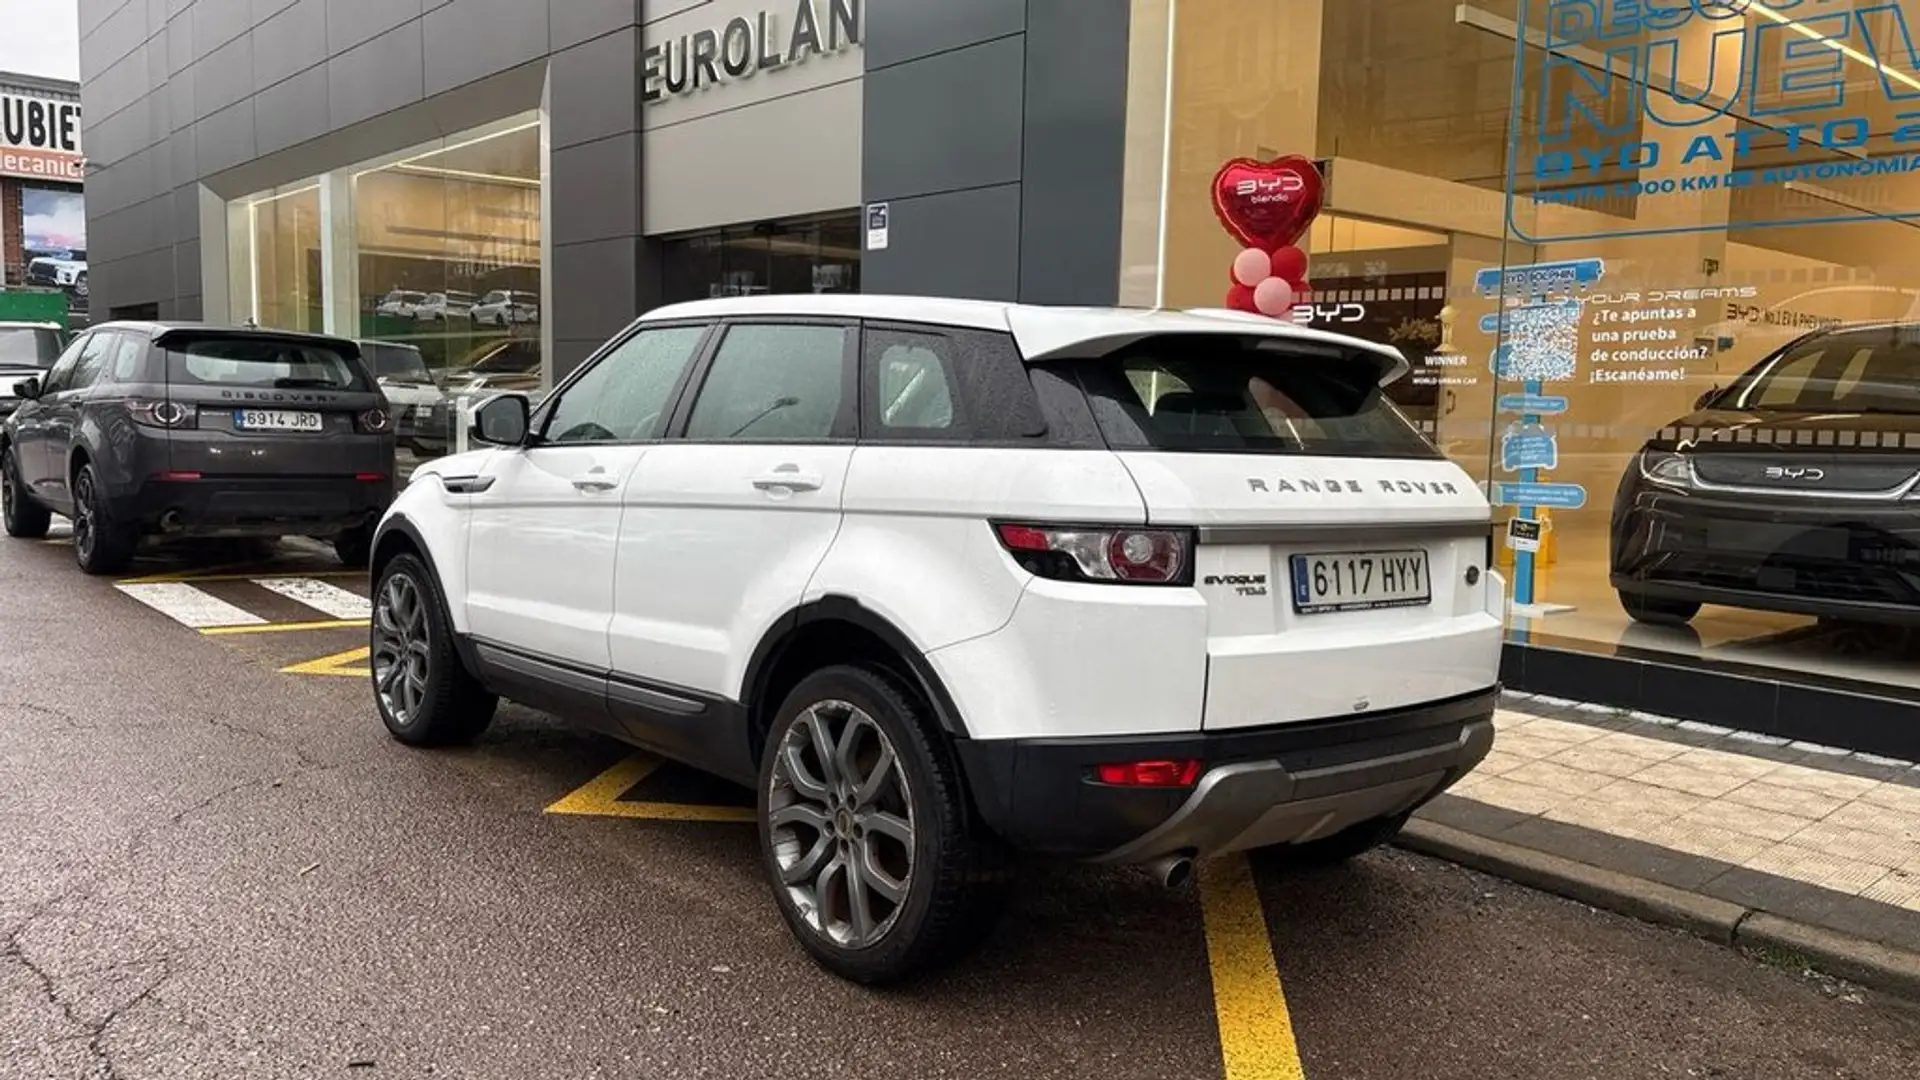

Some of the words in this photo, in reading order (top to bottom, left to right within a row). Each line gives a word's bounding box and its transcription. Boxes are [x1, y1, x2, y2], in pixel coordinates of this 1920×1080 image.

[4, 97, 82, 151] UBIE
[1681, 117, 1869, 165] ATTO
[1237, 176, 1304, 195] BYD
[1681, 175, 1717, 192] KM
[1648, 286, 1758, 302] DREAMS
[1292, 304, 1365, 322] BYD
[1592, 309, 1618, 326] ¿Te
[1622, 307, 1683, 323] apuntas
[1687, 308, 1696, 319] a
[1592, 331, 1619, 342] una
[1623, 328, 1677, 344] prueba
[1425, 355, 1468, 366] WINNER
[1590, 349, 1608, 362] de
[1612, 346, 1708, 361] conducción?
[1590, 367, 1685, 384] ¡Escanéame!
[222, 390, 338, 402] DISCOVERY
[247, 411, 285, 426] 6914
[291, 412, 318, 427] JRD
[1765, 466, 1824, 480] BYD
[1246, 478, 1364, 493] RANGE
[1378, 479, 1458, 495] ROVER
[1204, 575, 1266, 585] EVOQUE
[1314, 559, 1373, 597] 6117
[1381, 557, 1421, 593] HYY
